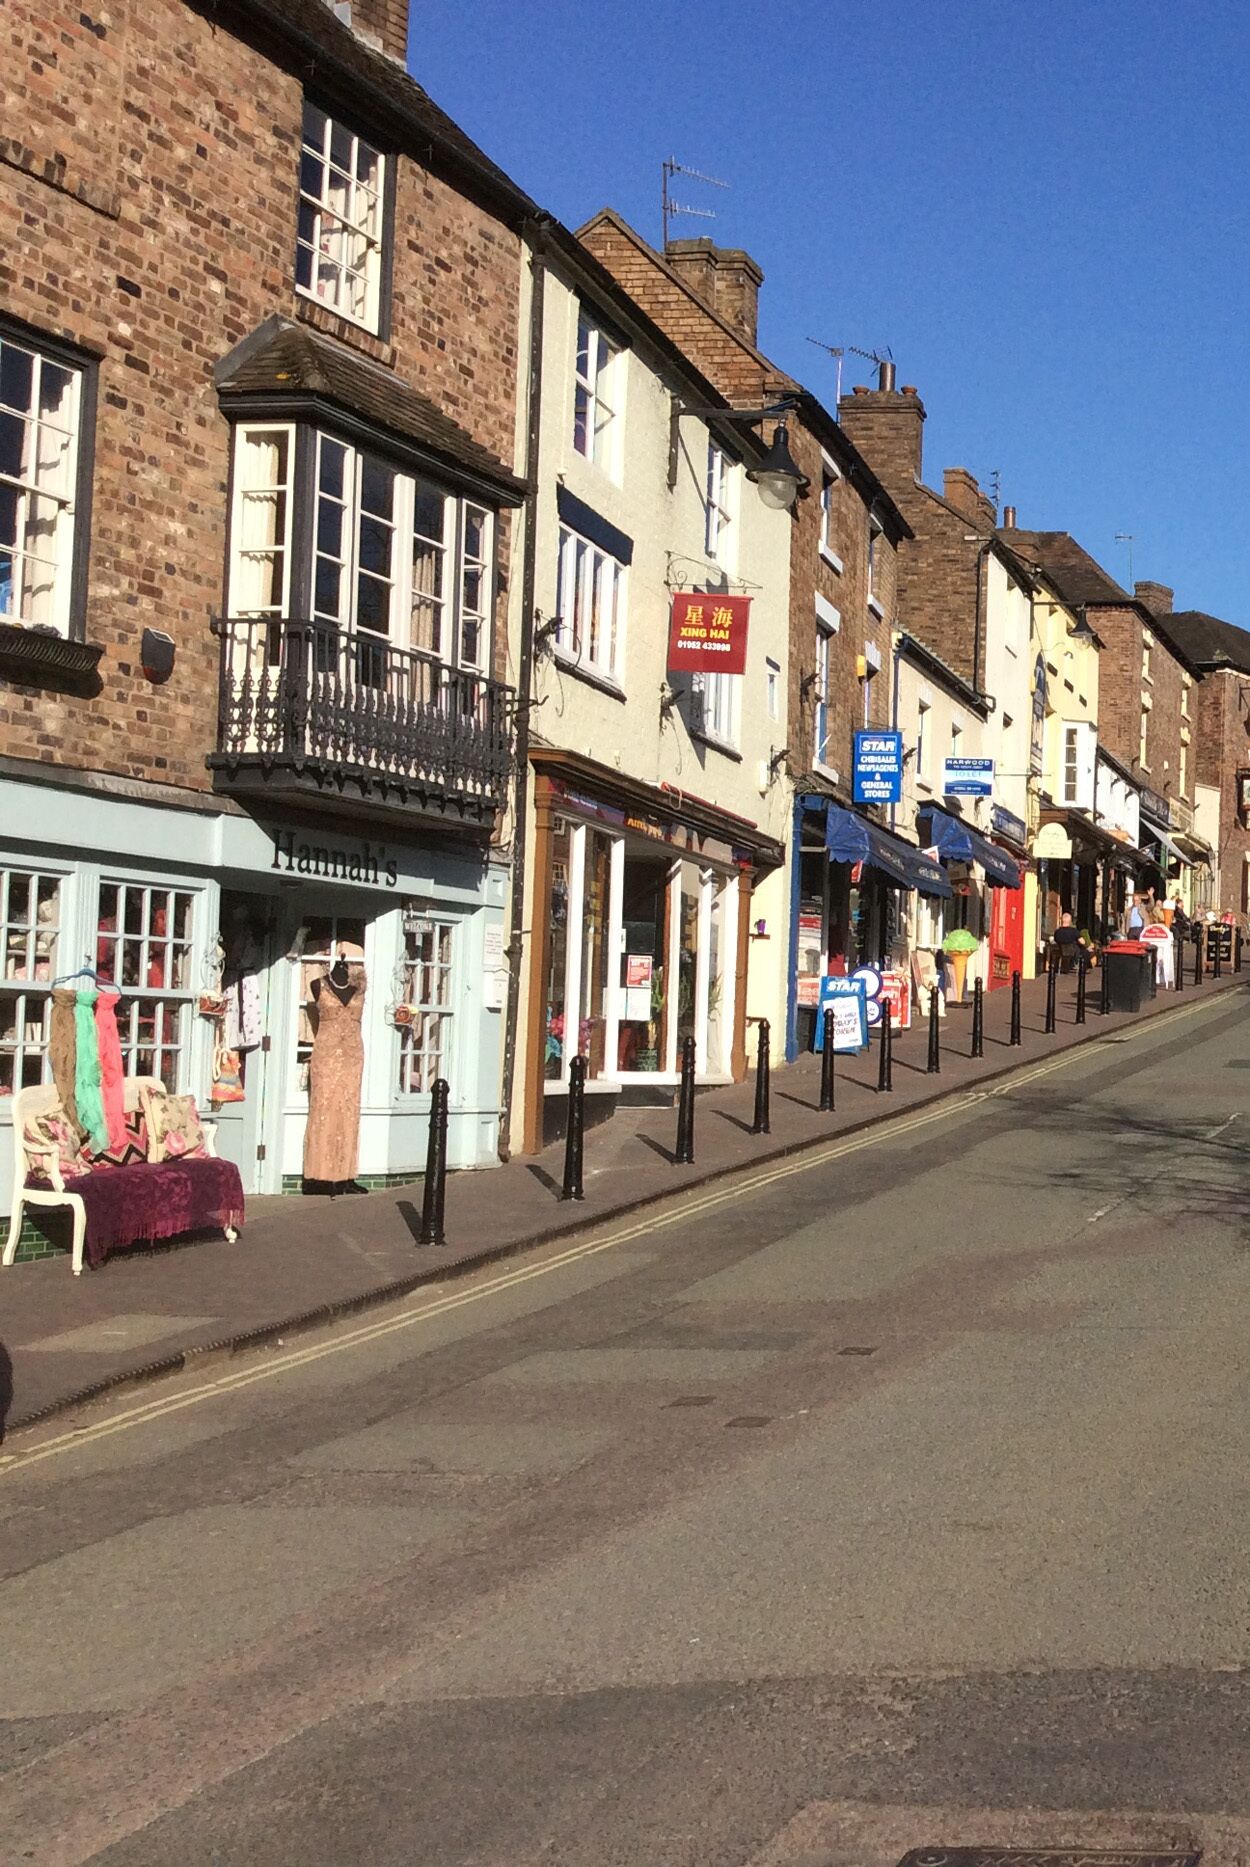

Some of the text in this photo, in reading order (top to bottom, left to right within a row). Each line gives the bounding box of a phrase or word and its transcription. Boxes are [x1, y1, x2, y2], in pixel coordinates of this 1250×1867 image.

[684, 604, 733, 628] 星海
[680, 627, 730, 640] XING HAI
[677, 640, 702, 650] 01952
[861, 741, 896, 752] STAR
[857, 764, 899, 772] NEWSAGENTS
[861, 781, 893, 790] GENERAL
[864, 790, 890, 798] STORES
[271, 828, 398, 888] Hannah's
[826, 980, 861, 993] STAR
